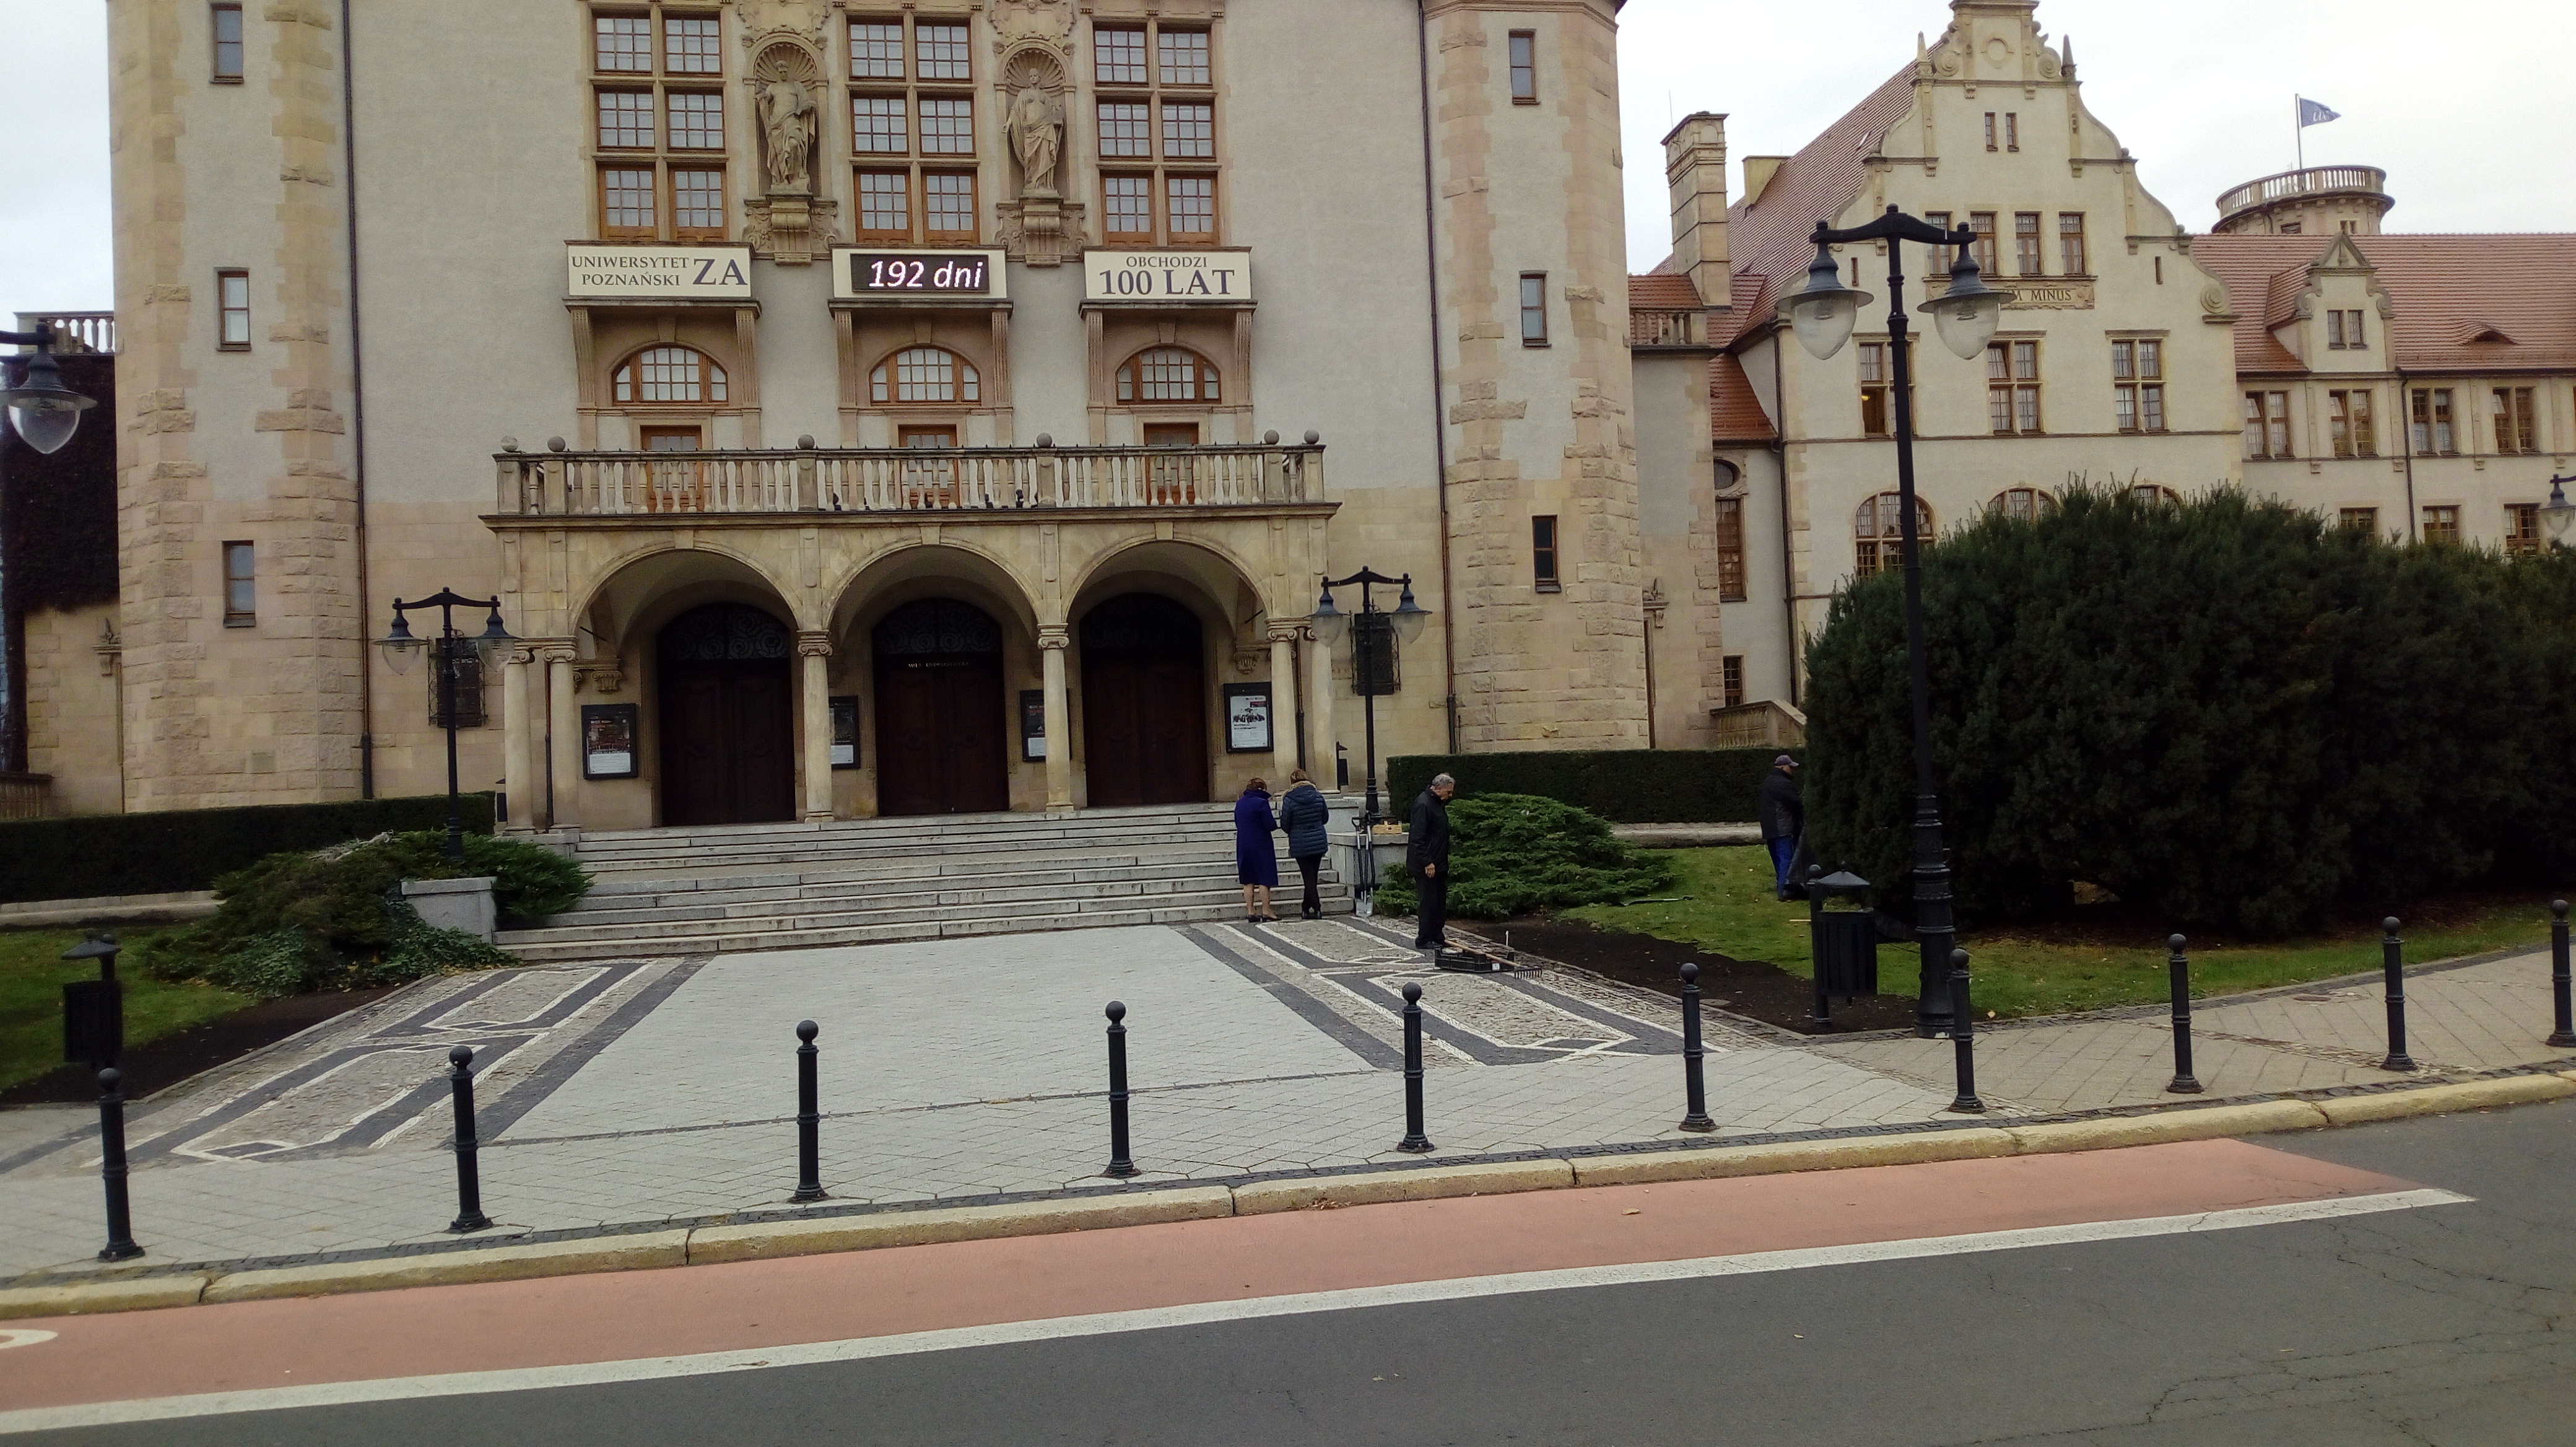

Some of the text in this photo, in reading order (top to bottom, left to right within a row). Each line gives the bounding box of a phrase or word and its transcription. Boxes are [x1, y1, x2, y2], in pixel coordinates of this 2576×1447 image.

[571, 256, 689, 268] UNIWERSYTET
[1126, 256, 1208, 267] OBCHODZI
[581, 271, 681, 286] POZNAŃSKI
[692, 258, 748, 286] ZA
[869, 260, 983, 287] 192 dni
[1099, 269, 1235, 295] 100 LAT
[2031, 289, 2071, 301] MINUS
